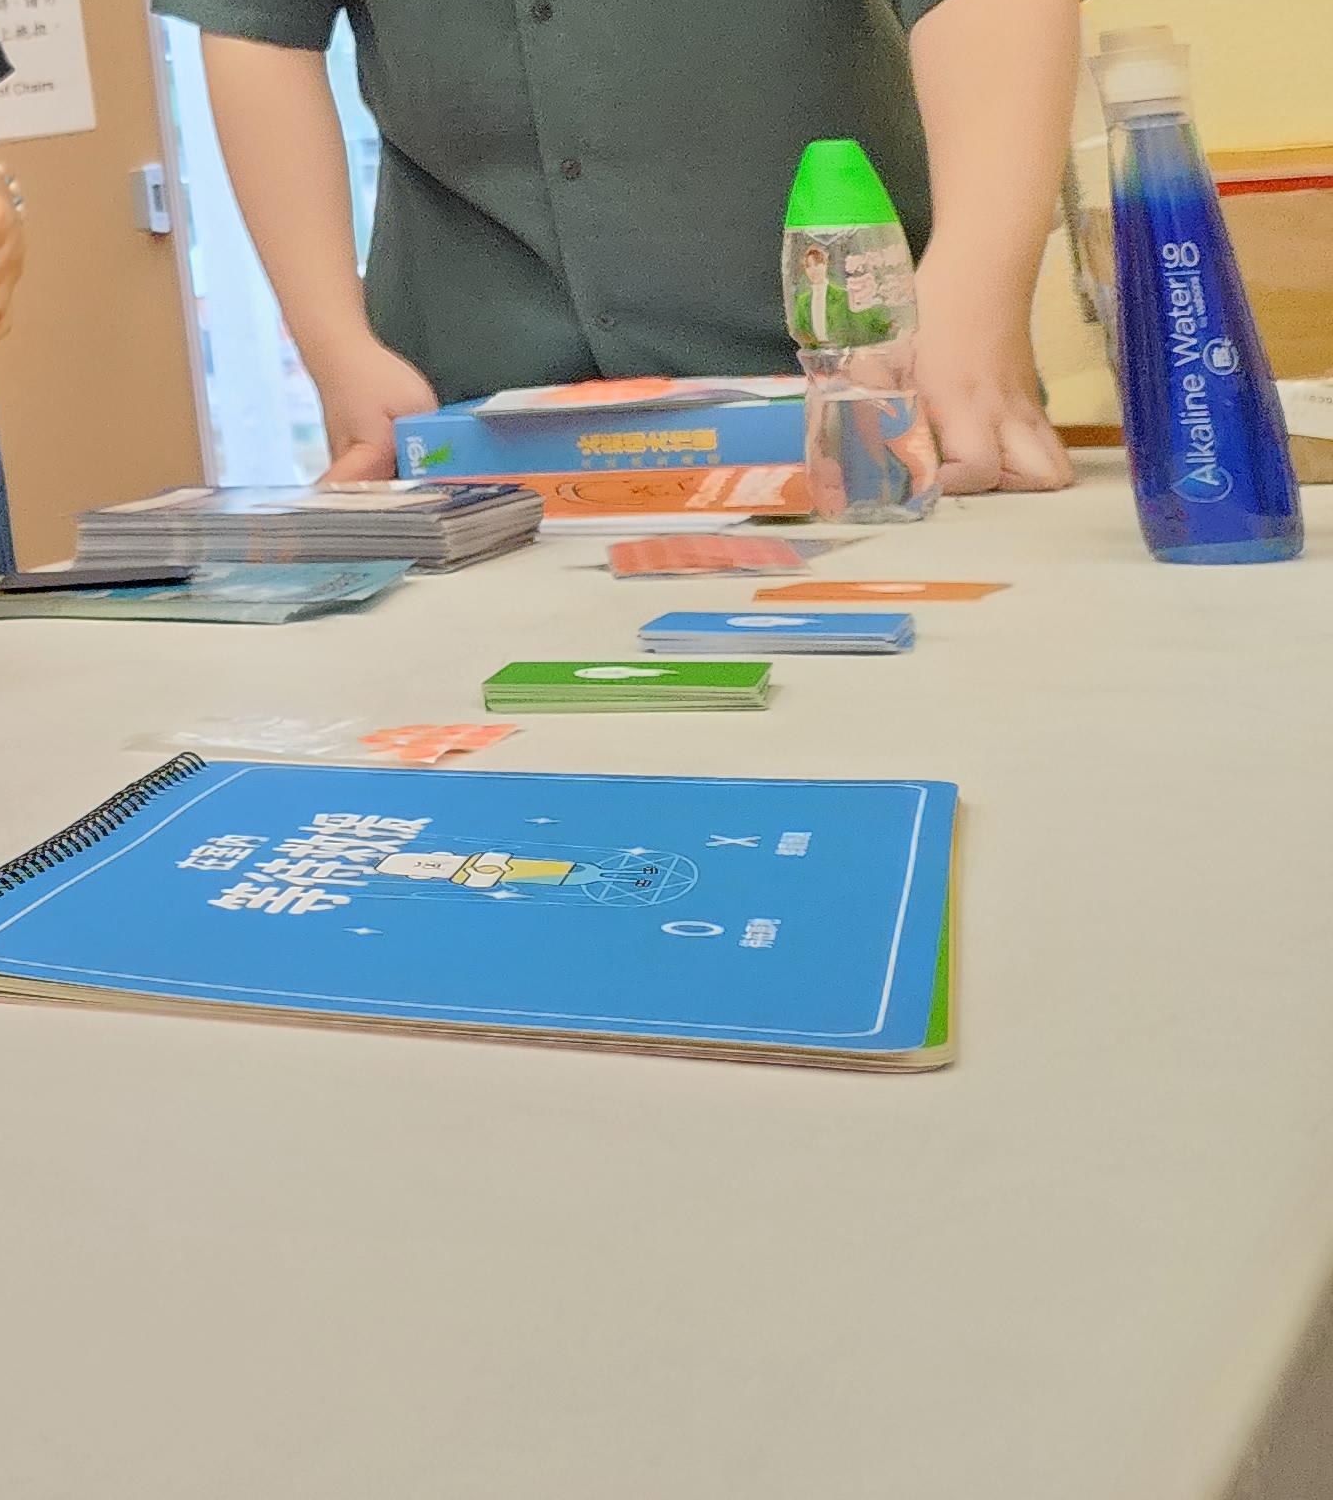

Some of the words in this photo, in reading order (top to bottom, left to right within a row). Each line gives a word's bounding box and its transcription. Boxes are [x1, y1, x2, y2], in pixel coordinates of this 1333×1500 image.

[1169, 276, 1201, 368] Water
[1180, 372, 1222, 487] Alkaline
[207, 812, 433, 915] 等待救援
